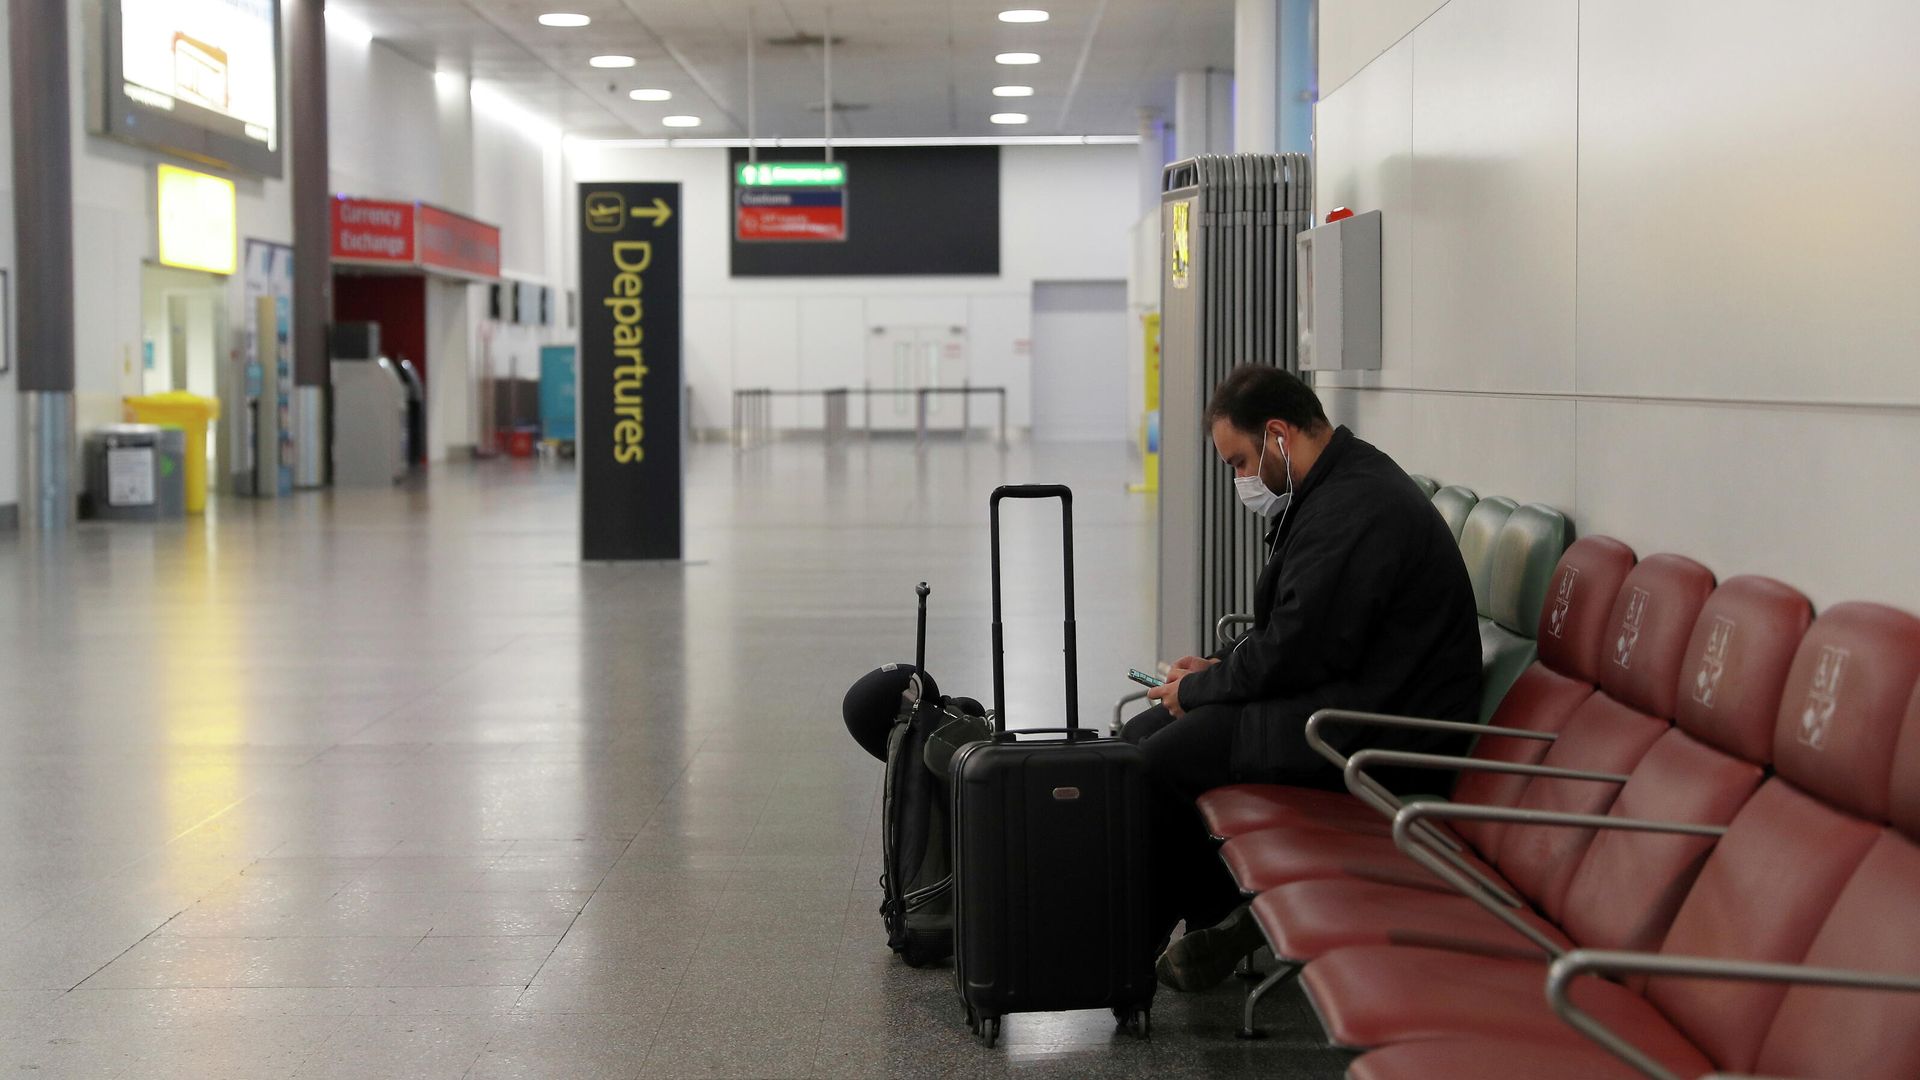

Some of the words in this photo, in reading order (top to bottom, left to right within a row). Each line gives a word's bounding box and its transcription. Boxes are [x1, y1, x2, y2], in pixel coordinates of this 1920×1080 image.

[341, 204, 402, 229] Currency
[340, 230, 406, 256] Exchange
[603, 240, 652, 464] Departures
